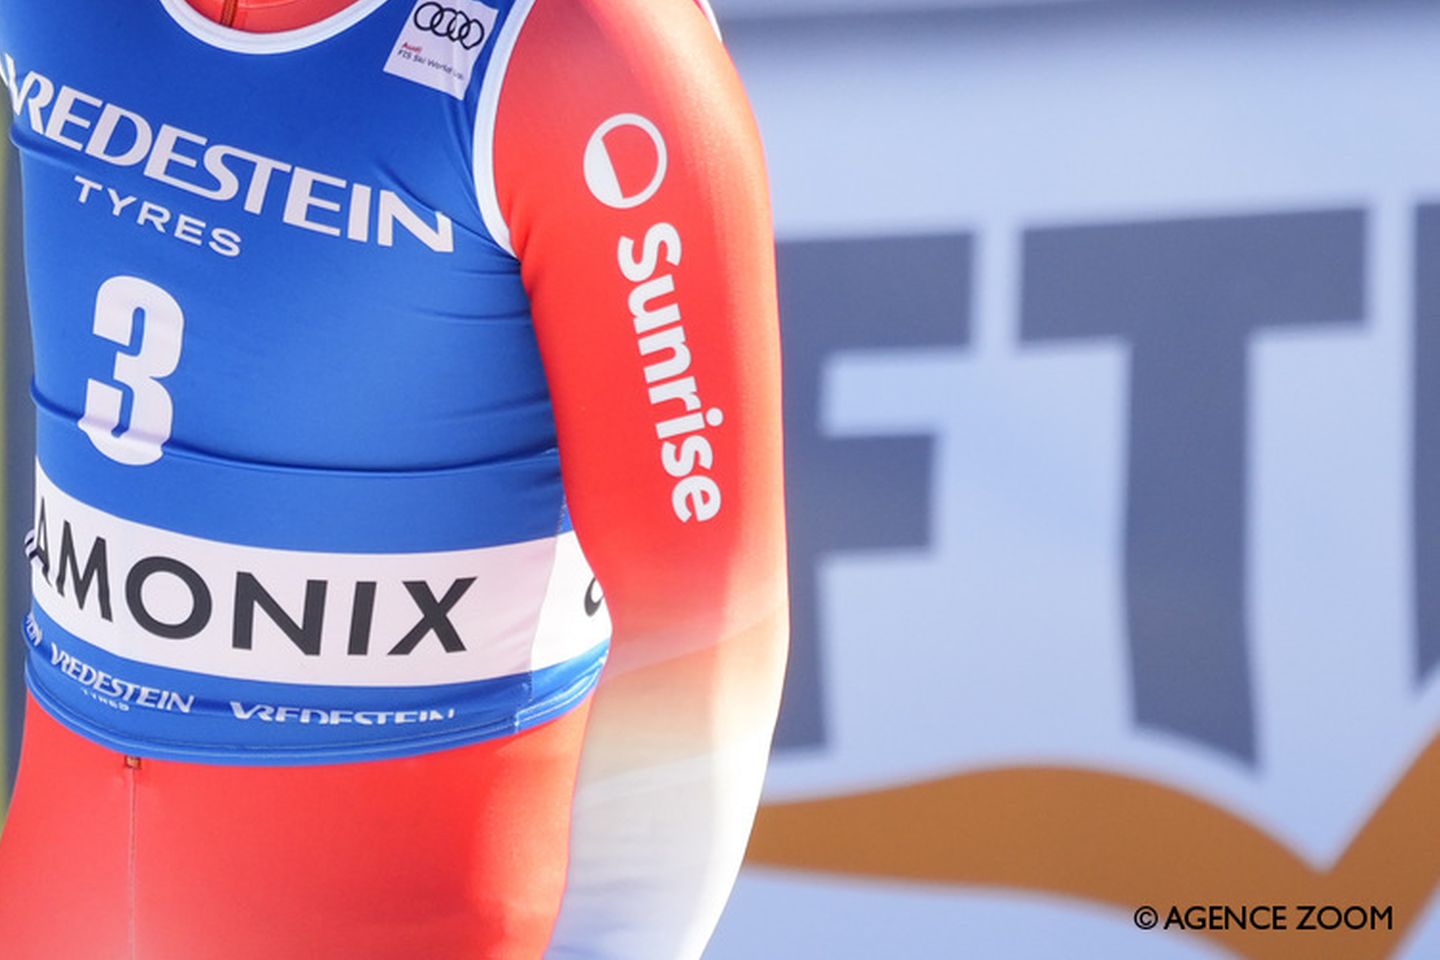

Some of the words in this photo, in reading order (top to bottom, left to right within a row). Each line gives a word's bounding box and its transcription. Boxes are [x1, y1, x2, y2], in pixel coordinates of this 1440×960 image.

[5, 53, 454, 253] VREDESTEIN
[74, 175, 242, 257] TYRES
[77, 275, 185, 466] 3
[617, 222, 724, 524] Sunrise
[775, 202, 1440, 775] FT
[51, 642, 195, 713] VREDESTEIN
